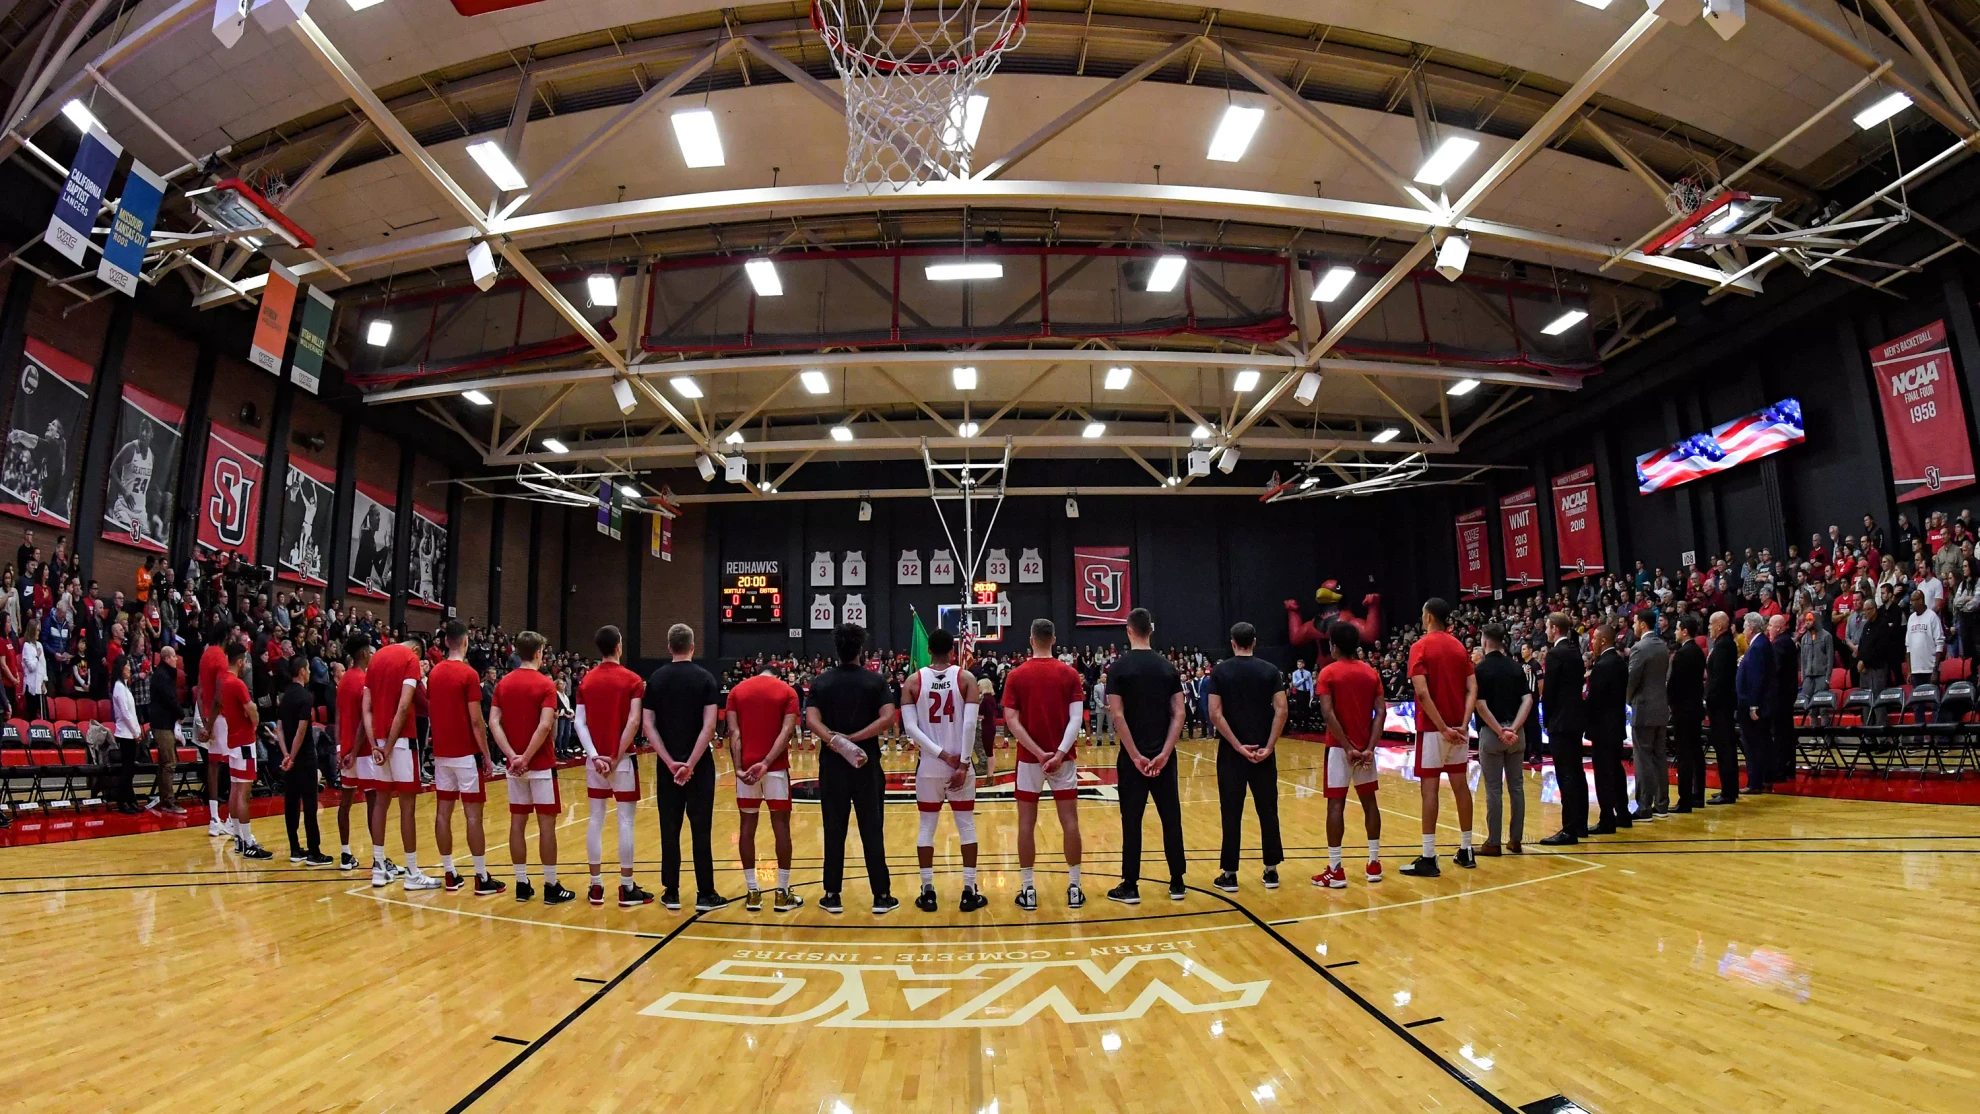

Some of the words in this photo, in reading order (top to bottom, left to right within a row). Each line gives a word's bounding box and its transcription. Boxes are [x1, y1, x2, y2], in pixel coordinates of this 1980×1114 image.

[71, 168, 102, 200] CALIFORNIA
[66, 180, 90, 205] BAPTIST
[62, 192, 89, 217] LANCERS
[118, 207, 144, 232] MISSOURI
[57, 227, 77, 249] WAC
[114, 219, 136, 241] KANSAS
[134, 230, 148, 248] CITY
[109, 267, 128, 288] WAC
[1883, 343, 1901, 359] MEN'S
[1899, 330, 1932, 353] BASKETBALL
[1891, 360, 1940, 397] NCAA
[1904, 390, 1921, 404] FINAL
[1919, 384, 1935, 399] FOUR
[1910, 400, 1937, 424] 1958
[1924, 465, 1941, 491] SU
[132, 477, 148, 495] 24
[209, 456, 256, 546] SU
[1561, 489, 1588, 511] NCAA
[1508, 509, 1530, 531] WNIT
[1570, 518, 1586, 533] 2018
[1515, 533, 1528, 547] 2013
[1516, 545, 1529, 559] 2017
[726, 561, 778, 574] REDHAWKS
[819, 566, 826, 578] 3
[851, 565, 858, 577] 4
[902, 564, 918, 576] 32
[934, 563, 950, 576] 44
[990, 562, 1006, 575] 33
[1023, 562, 1039, 574] 42
[737, 576, 766, 588] 20:00
[974, 582, 997, 592] 20:00
[1083, 563, 1124, 613] SU
[732, 594, 740, 605] 0
[773, 593, 780, 605] 0
[978, 591, 993, 604] 30
[726, 609, 732, 618] 0
[773, 608, 780, 617] 0
[815, 608, 831, 621] 20
[847, 608, 863, 621] 22
[791, 630, 800, 638] 104
[931, 681, 951, 691] JONES
[928, 689, 955, 724] 24
[30, 728, 52, 738] SEATTLE
[62, 730, 83, 739] SEATTLE
[1090, 939, 1197, 957] LEARN
[733, 949, 861, 962] INSPIRE
[897, 949, 1052, 963] COMPETE
[635, 951, 1272, 1029] WAC
